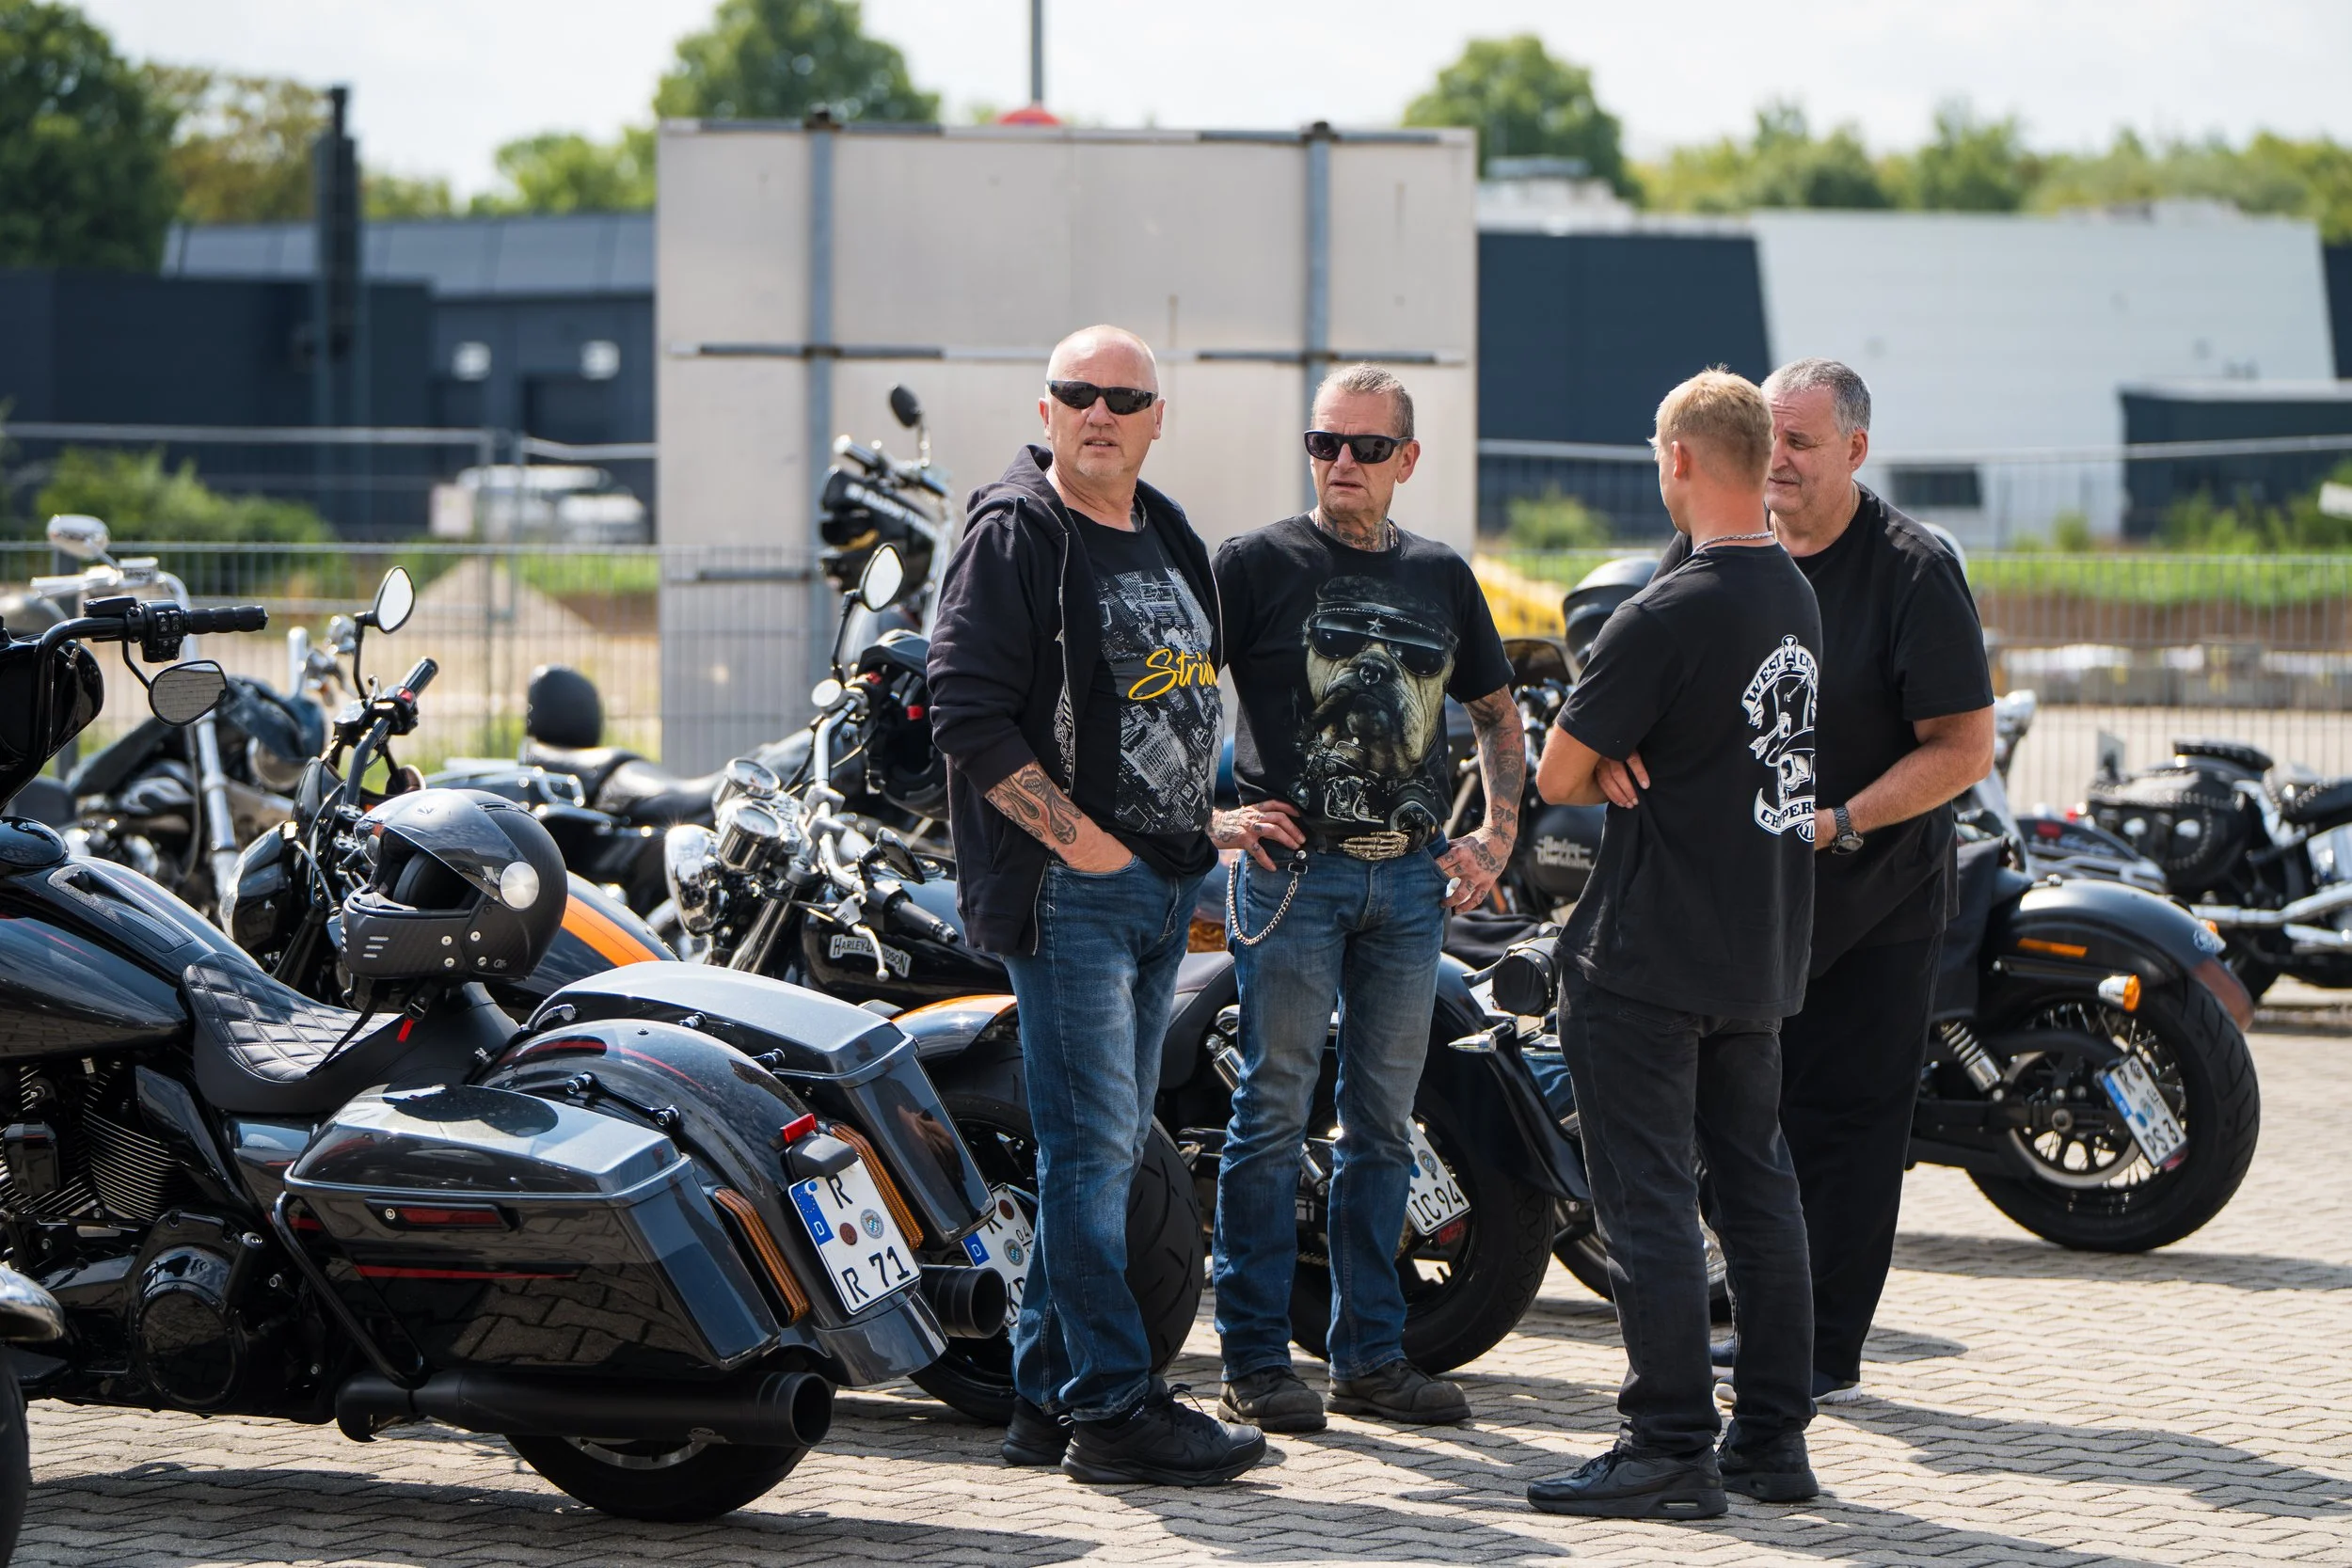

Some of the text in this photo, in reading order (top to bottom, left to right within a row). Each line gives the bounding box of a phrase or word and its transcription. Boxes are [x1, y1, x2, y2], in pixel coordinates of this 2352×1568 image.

[1744, 653, 1816, 703] WEST COA
[834, 936, 908, 974] HARLEY-DIDSON
[826, 1176, 853, 1210] R
[1434, 1180, 1466, 1214] 94
[813, 1221, 826, 1237] D
[971, 1243, 983, 1258] D
[841, 1244, 911, 1304] R 71
